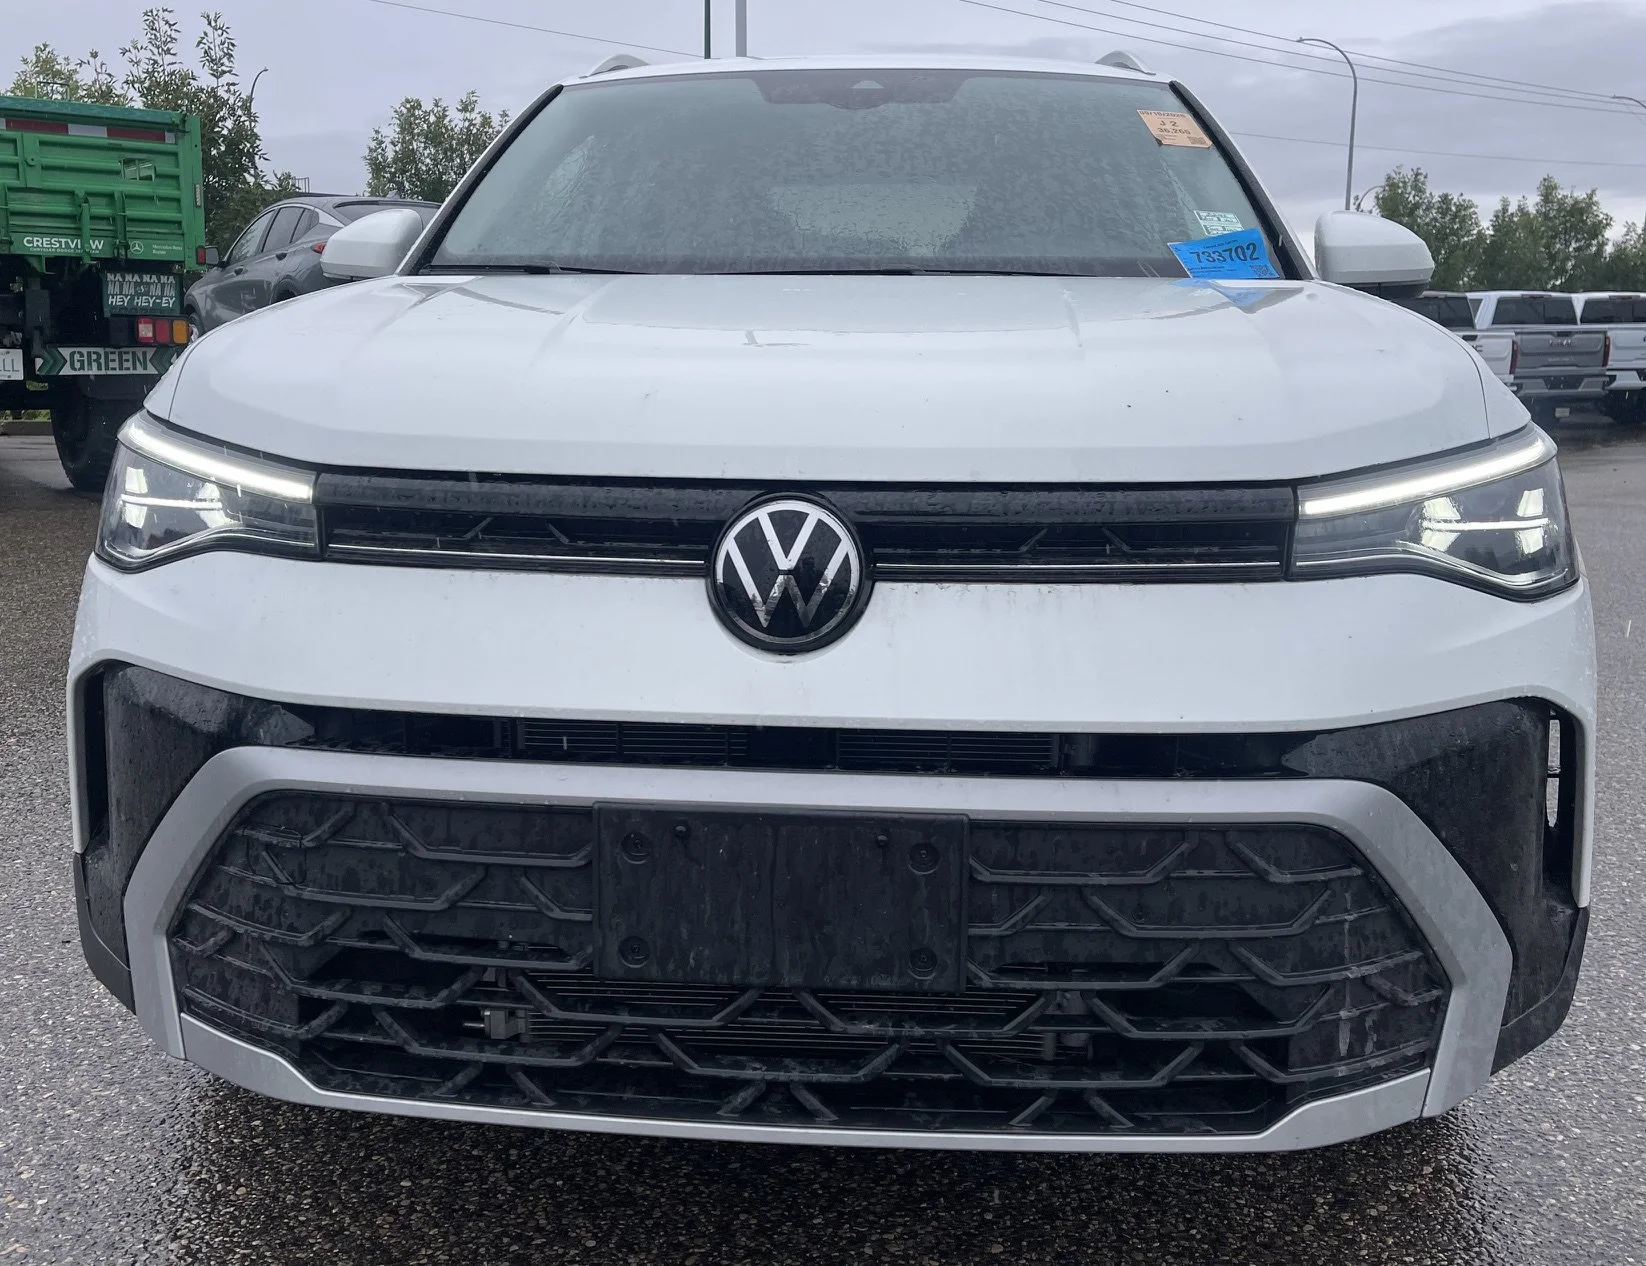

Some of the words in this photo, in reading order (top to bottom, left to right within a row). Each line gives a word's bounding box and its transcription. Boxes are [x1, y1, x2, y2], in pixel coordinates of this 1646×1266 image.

[23, 237, 104, 250] CRESTVIW
[1189, 242, 1260, 263] 733702
[107, 273, 122, 281] NA
[125, 273, 140, 282] NA
[143, 274, 158, 283] NA
[160, 275, 175, 284] NA
[108, 281, 120, 294] NA
[123, 281, 135, 295] NA
[149, 283, 161, 296] NA
[164, 283, 175, 296] NA
[108, 295, 131, 307] HEY
[134, 296, 176, 308] HEY-EY
[0, 358, 20, 372] LL
[68, 350, 148, 372] GREEN
